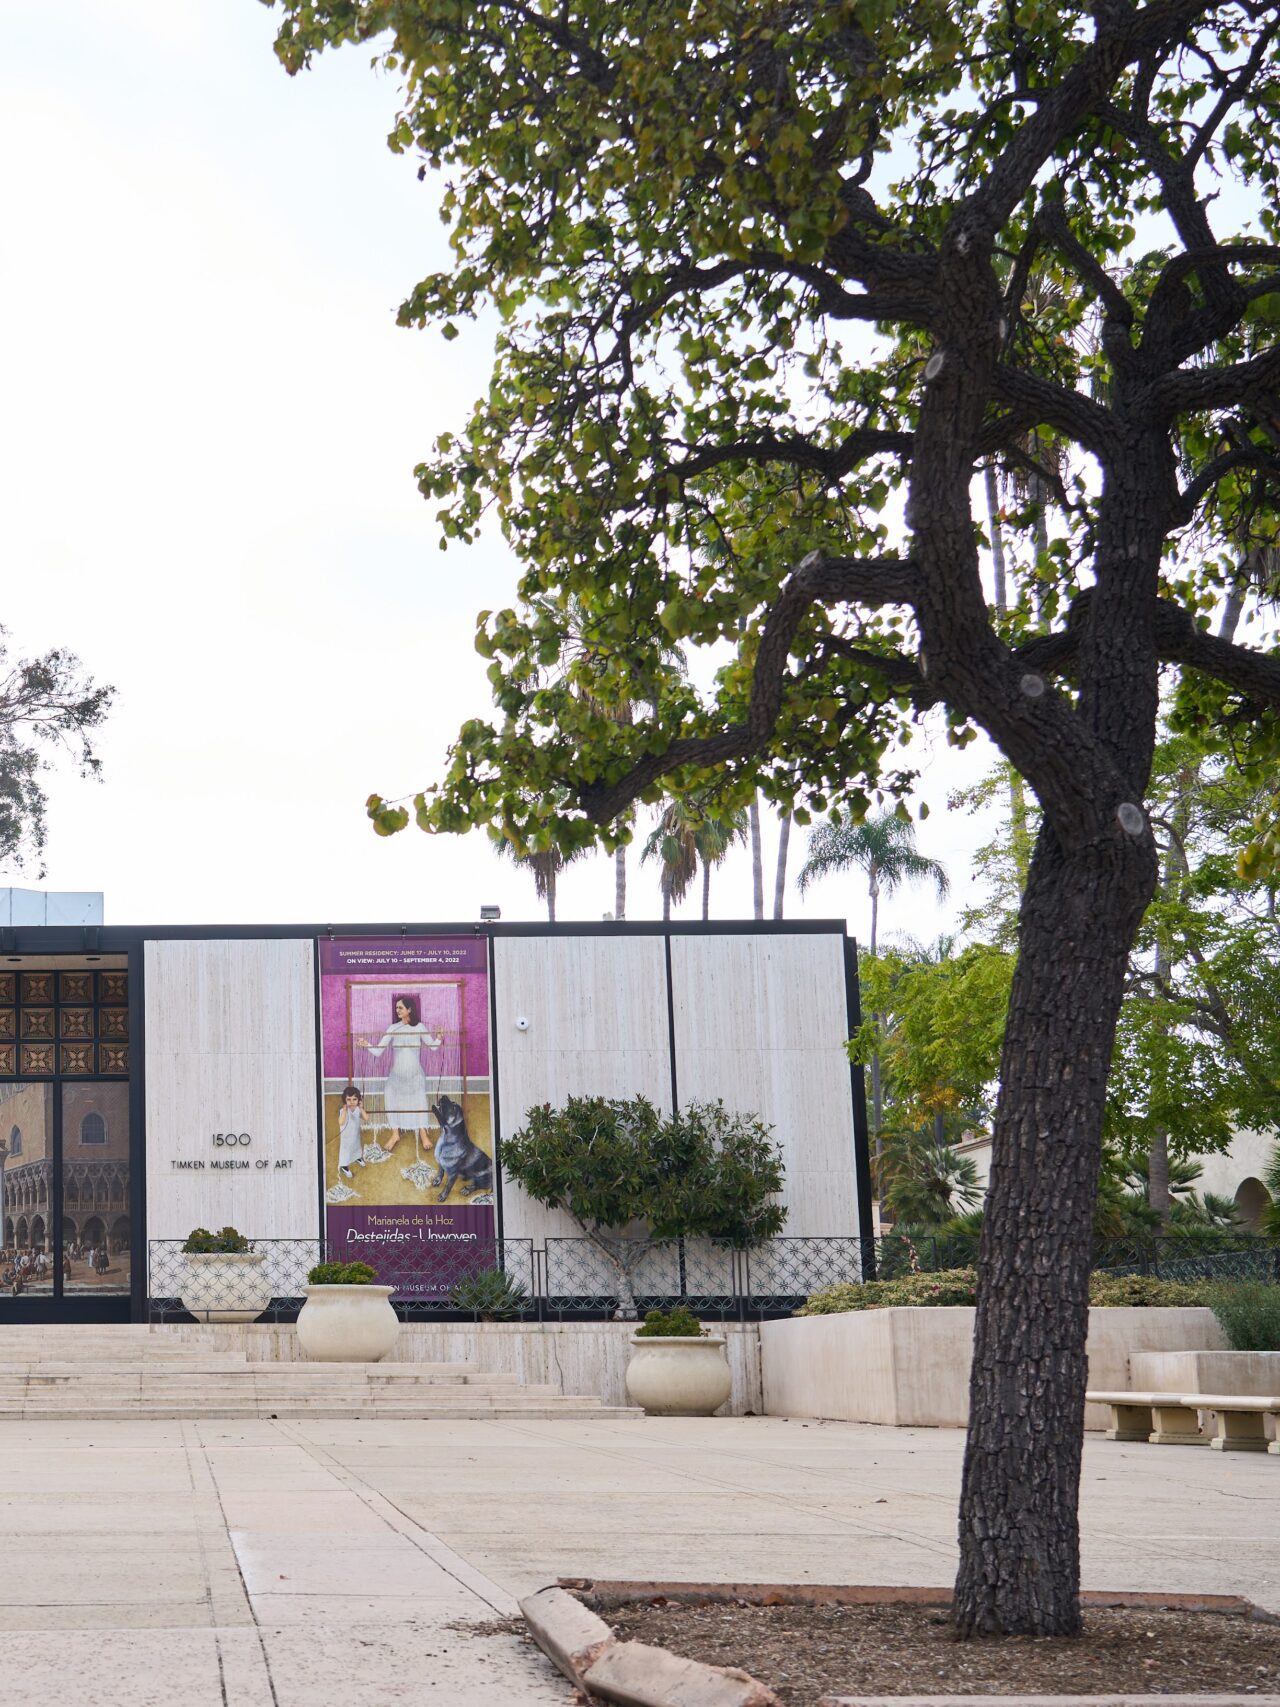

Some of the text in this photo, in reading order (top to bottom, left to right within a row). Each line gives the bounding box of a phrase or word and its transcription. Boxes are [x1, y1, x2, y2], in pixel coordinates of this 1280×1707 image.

[212, 1134, 251, 1146] 1500
[171, 1160, 293, 1169] TIMKEN MUSEUM OF ART
[368, 1215, 454, 1225] Marianela de la Hoz
